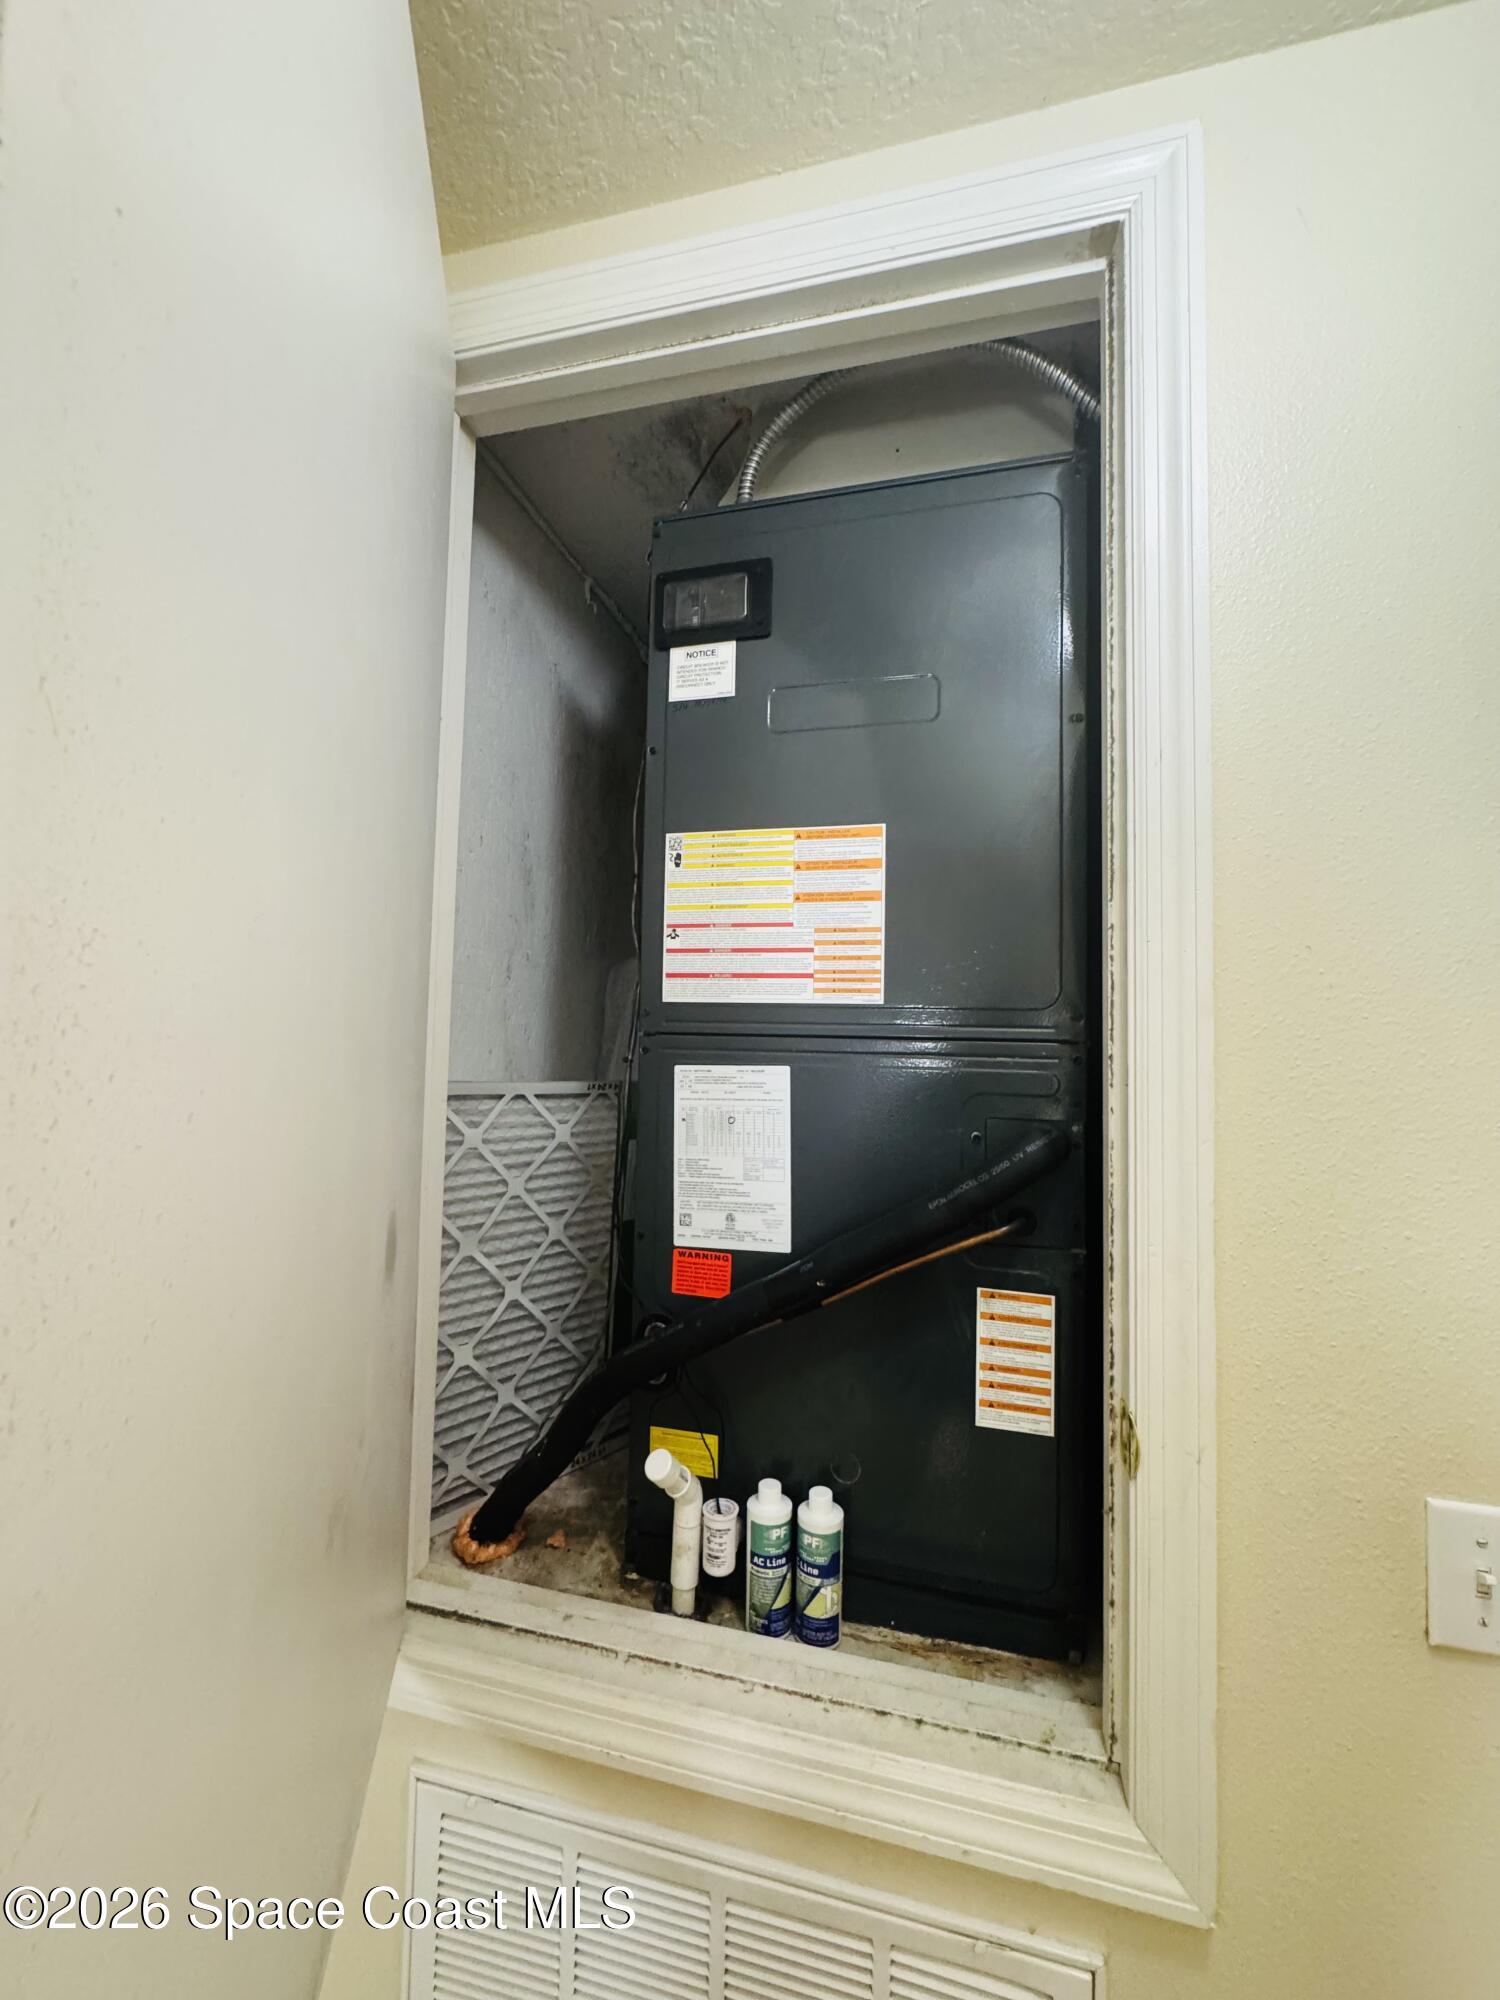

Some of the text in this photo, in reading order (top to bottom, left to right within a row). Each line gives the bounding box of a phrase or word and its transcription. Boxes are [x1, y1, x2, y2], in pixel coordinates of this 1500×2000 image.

[686, 648, 717, 659] NOTICE
[678, 1250, 729, 1262] WARNING
[772, 1526, 788, 1540] PF
[804, 1535, 821, 1549] PF
[753, 1556, 786, 1567] AC Line
[800, 1562, 819, 1576] Line
